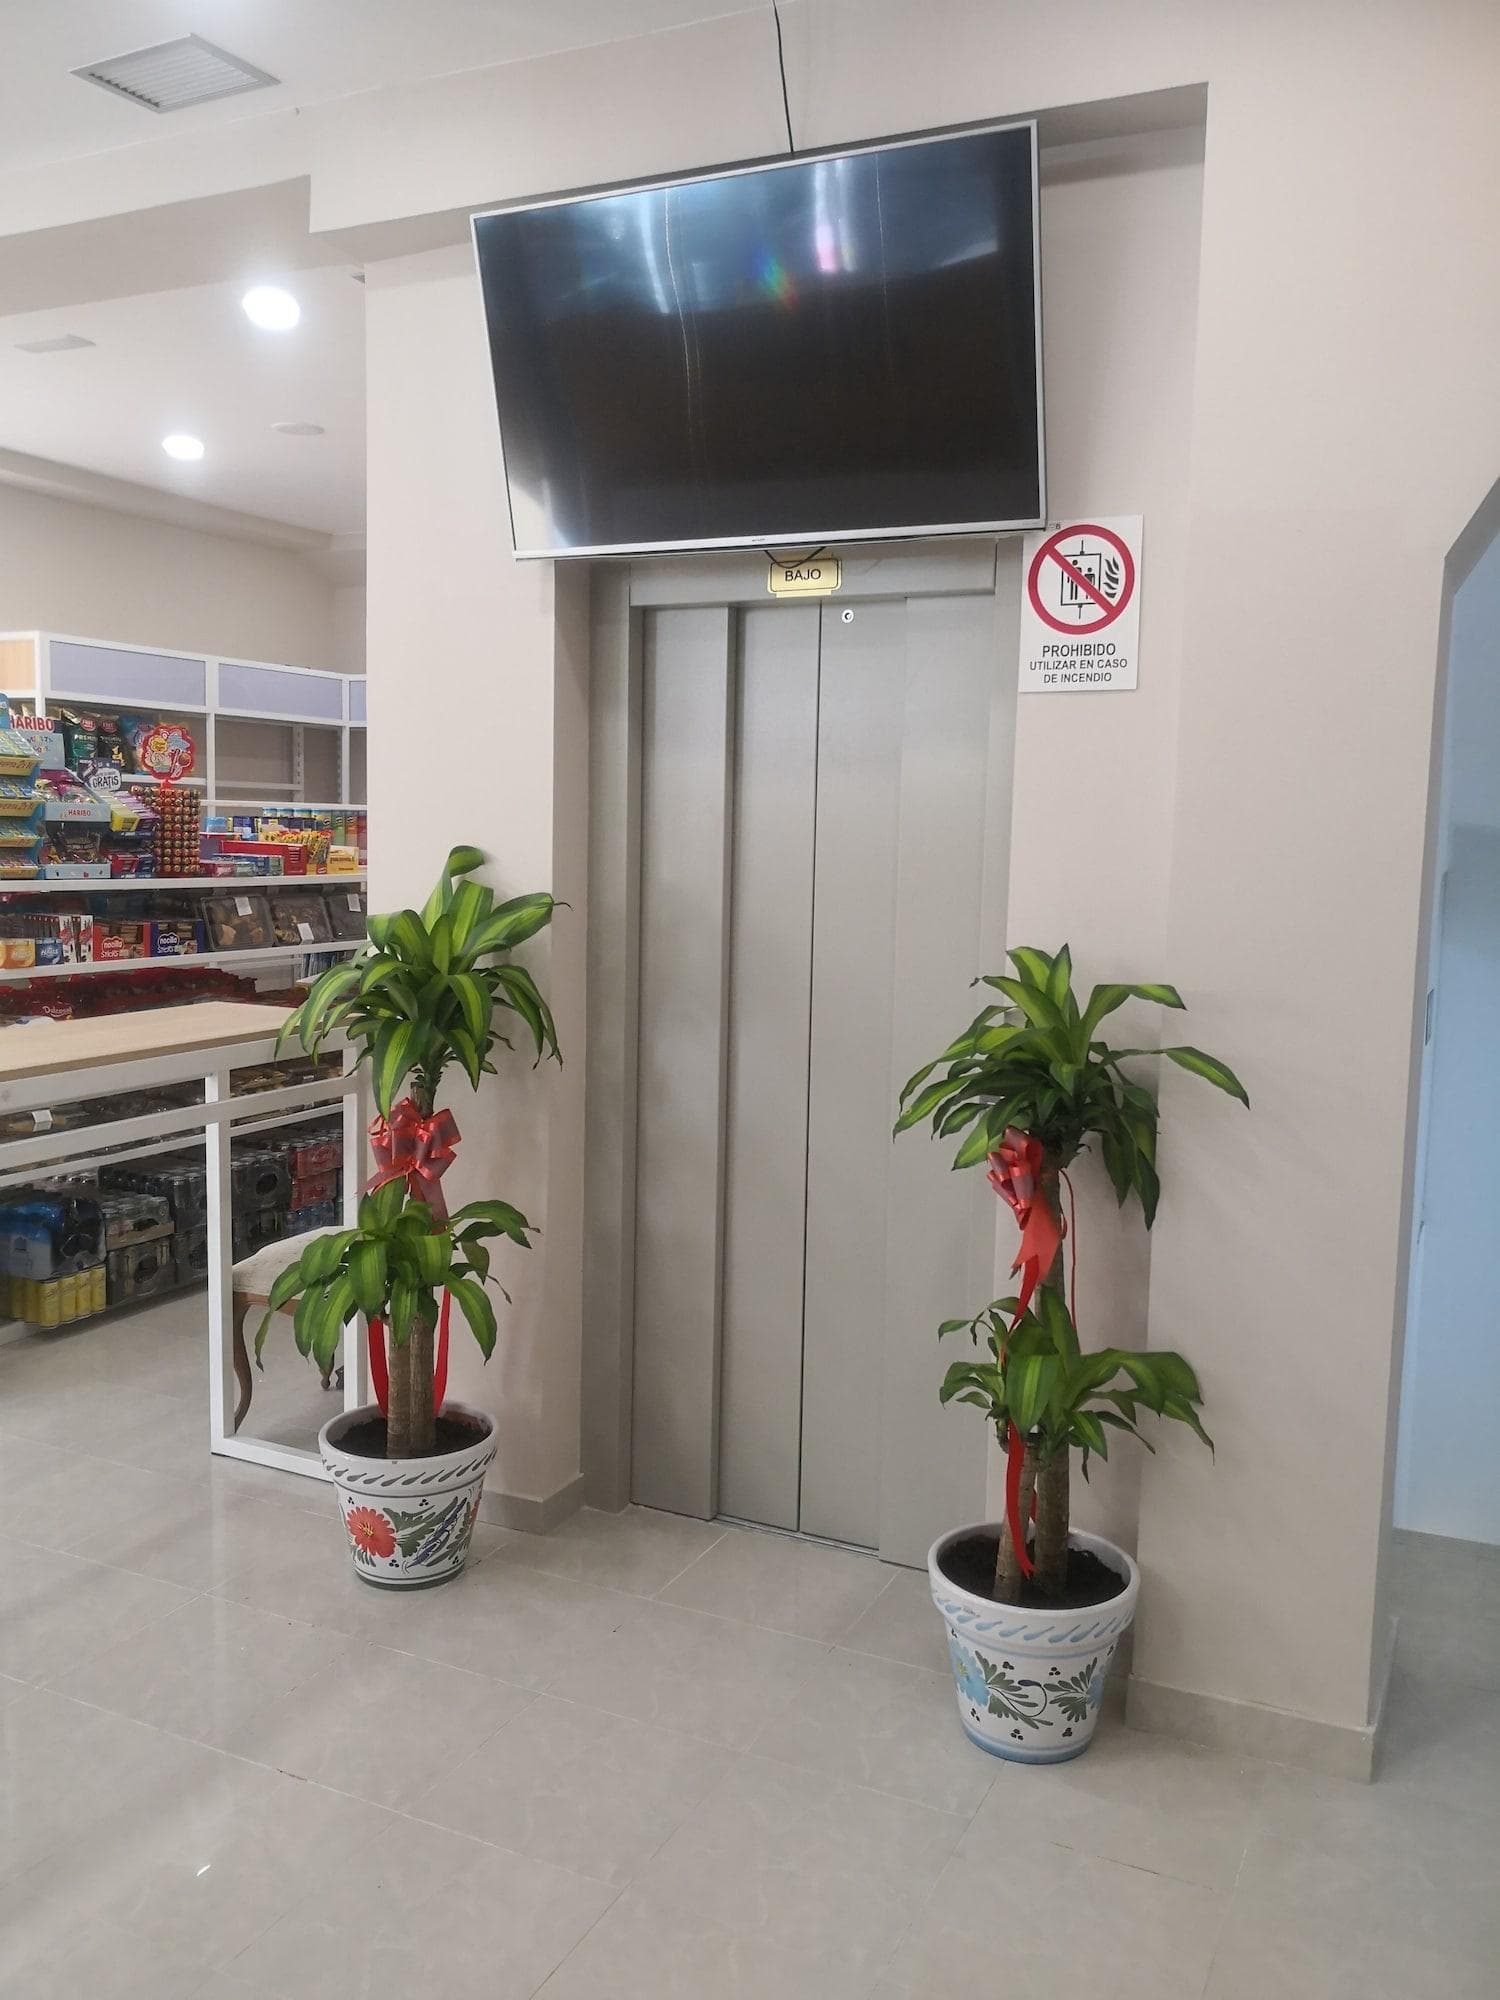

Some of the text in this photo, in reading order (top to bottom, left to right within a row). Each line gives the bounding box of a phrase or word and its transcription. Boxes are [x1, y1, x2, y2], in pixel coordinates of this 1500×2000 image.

[784, 568, 822, 582] BAJO
[1042, 643, 1116, 658] PROHIBIDO
[1029, 658, 1128, 671] UTILIZAR EN CASO
[1043, 672, 1112, 684] DE INCENDIO
[92, 775, 119, 788] GRATIS
